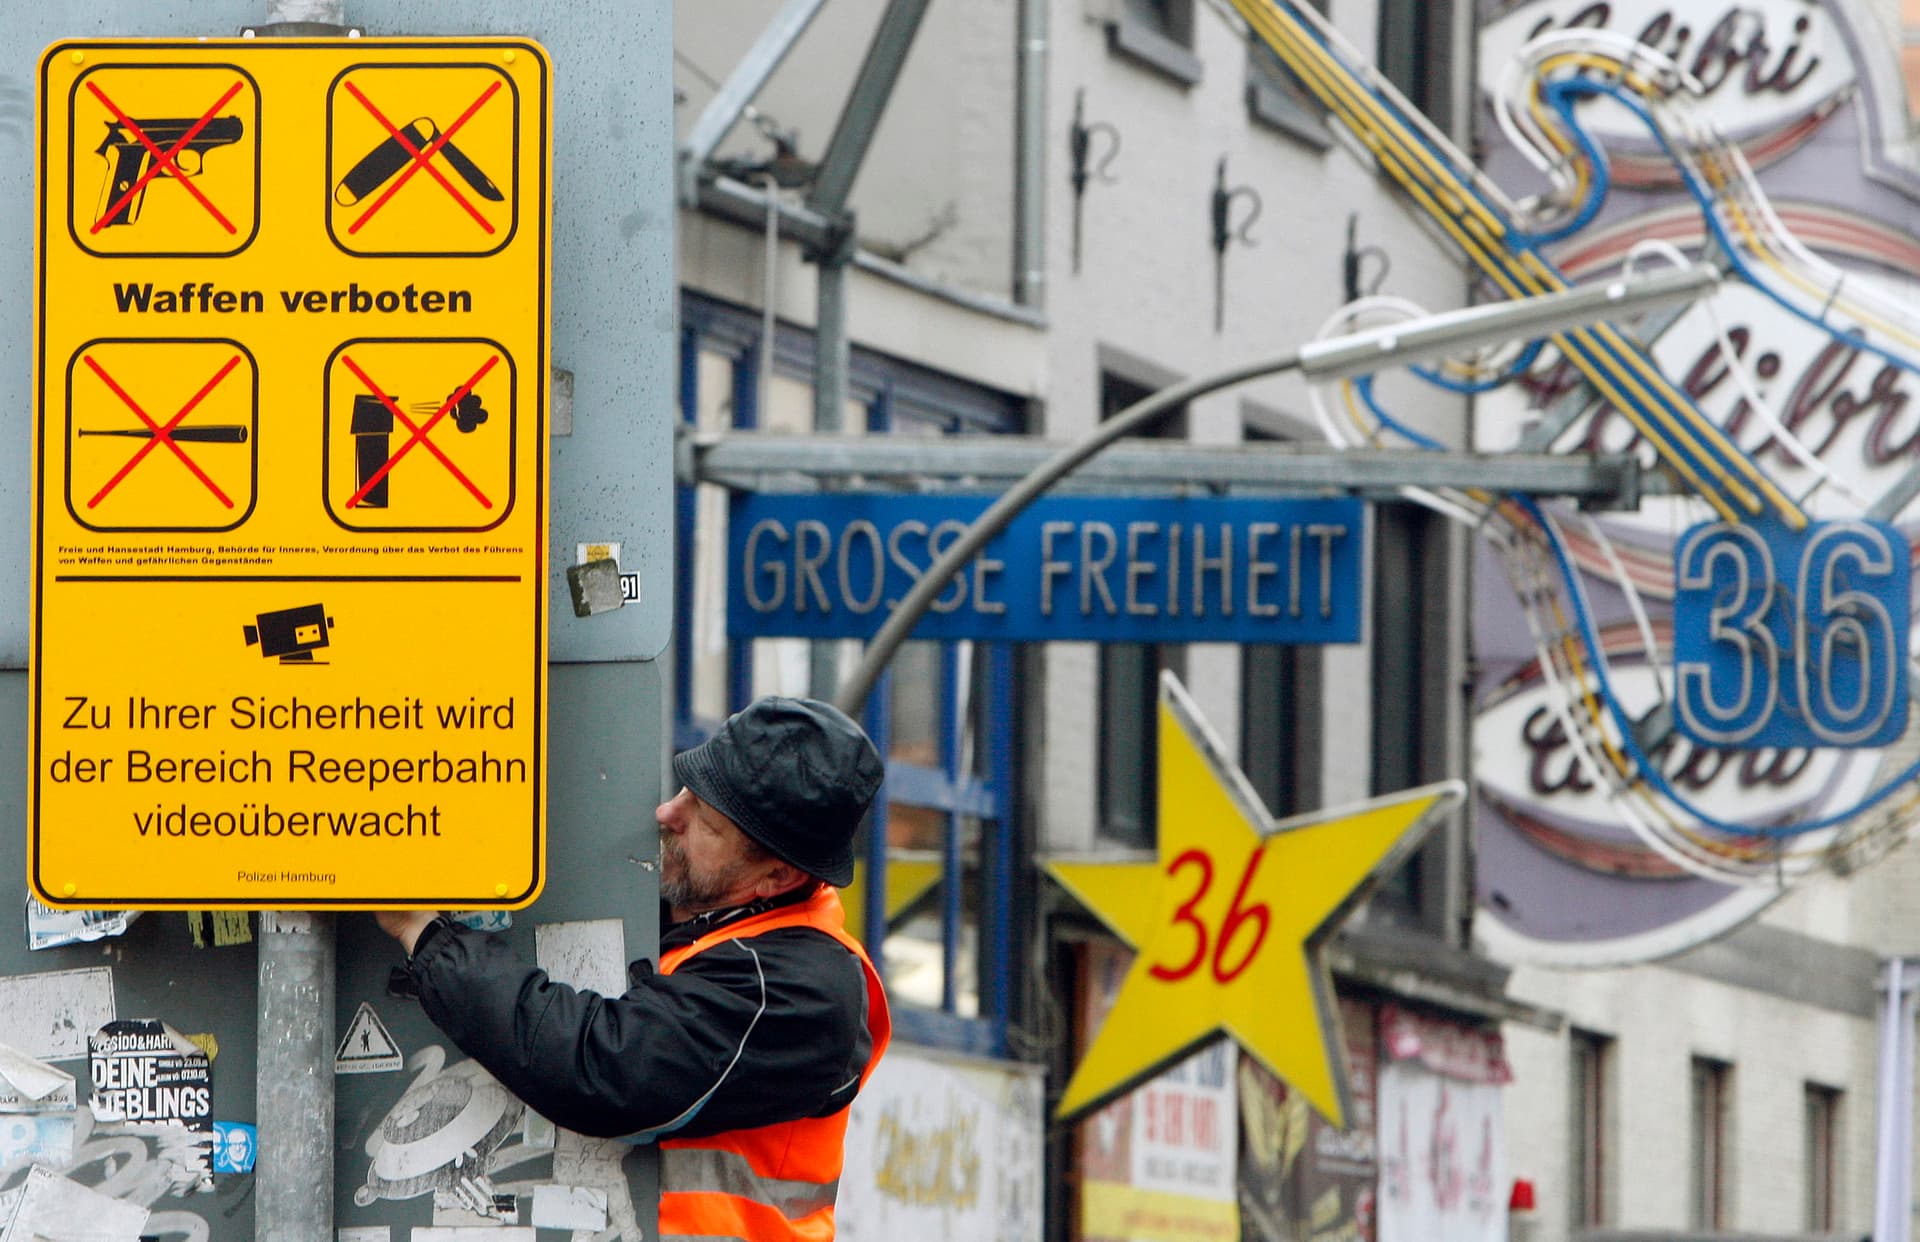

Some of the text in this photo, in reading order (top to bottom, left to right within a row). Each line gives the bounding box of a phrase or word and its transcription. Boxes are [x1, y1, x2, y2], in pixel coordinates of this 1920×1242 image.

[113, 282, 472, 313] Waffen verboten
[58, 545, 524, 556] Freie und Hansestadt Hamburg, Behörde für Inneres, Verordnung über das Verbot des Führens
[78, 556, 113, 565] Waffen
[115, 556, 134, 565] und
[136, 556, 199, 567] gefährlichen
[201, 556, 274, 567] Gegenständen
[743, 518, 1348, 617] GROSSE FREIHEIT
[1677, 520, 1897, 743] 36
[62, 696, 514, 730] Zu Ihrer Sicherheit wird
[50, 750, 526, 791] der Bereich Reeperbahn
[133, 803, 441, 837] videoüberwacht
[237, 871, 336, 884] Polizei Hamburg
[1147, 846, 1272, 985] 36
[92, 1057, 158, 1089] DEINE
